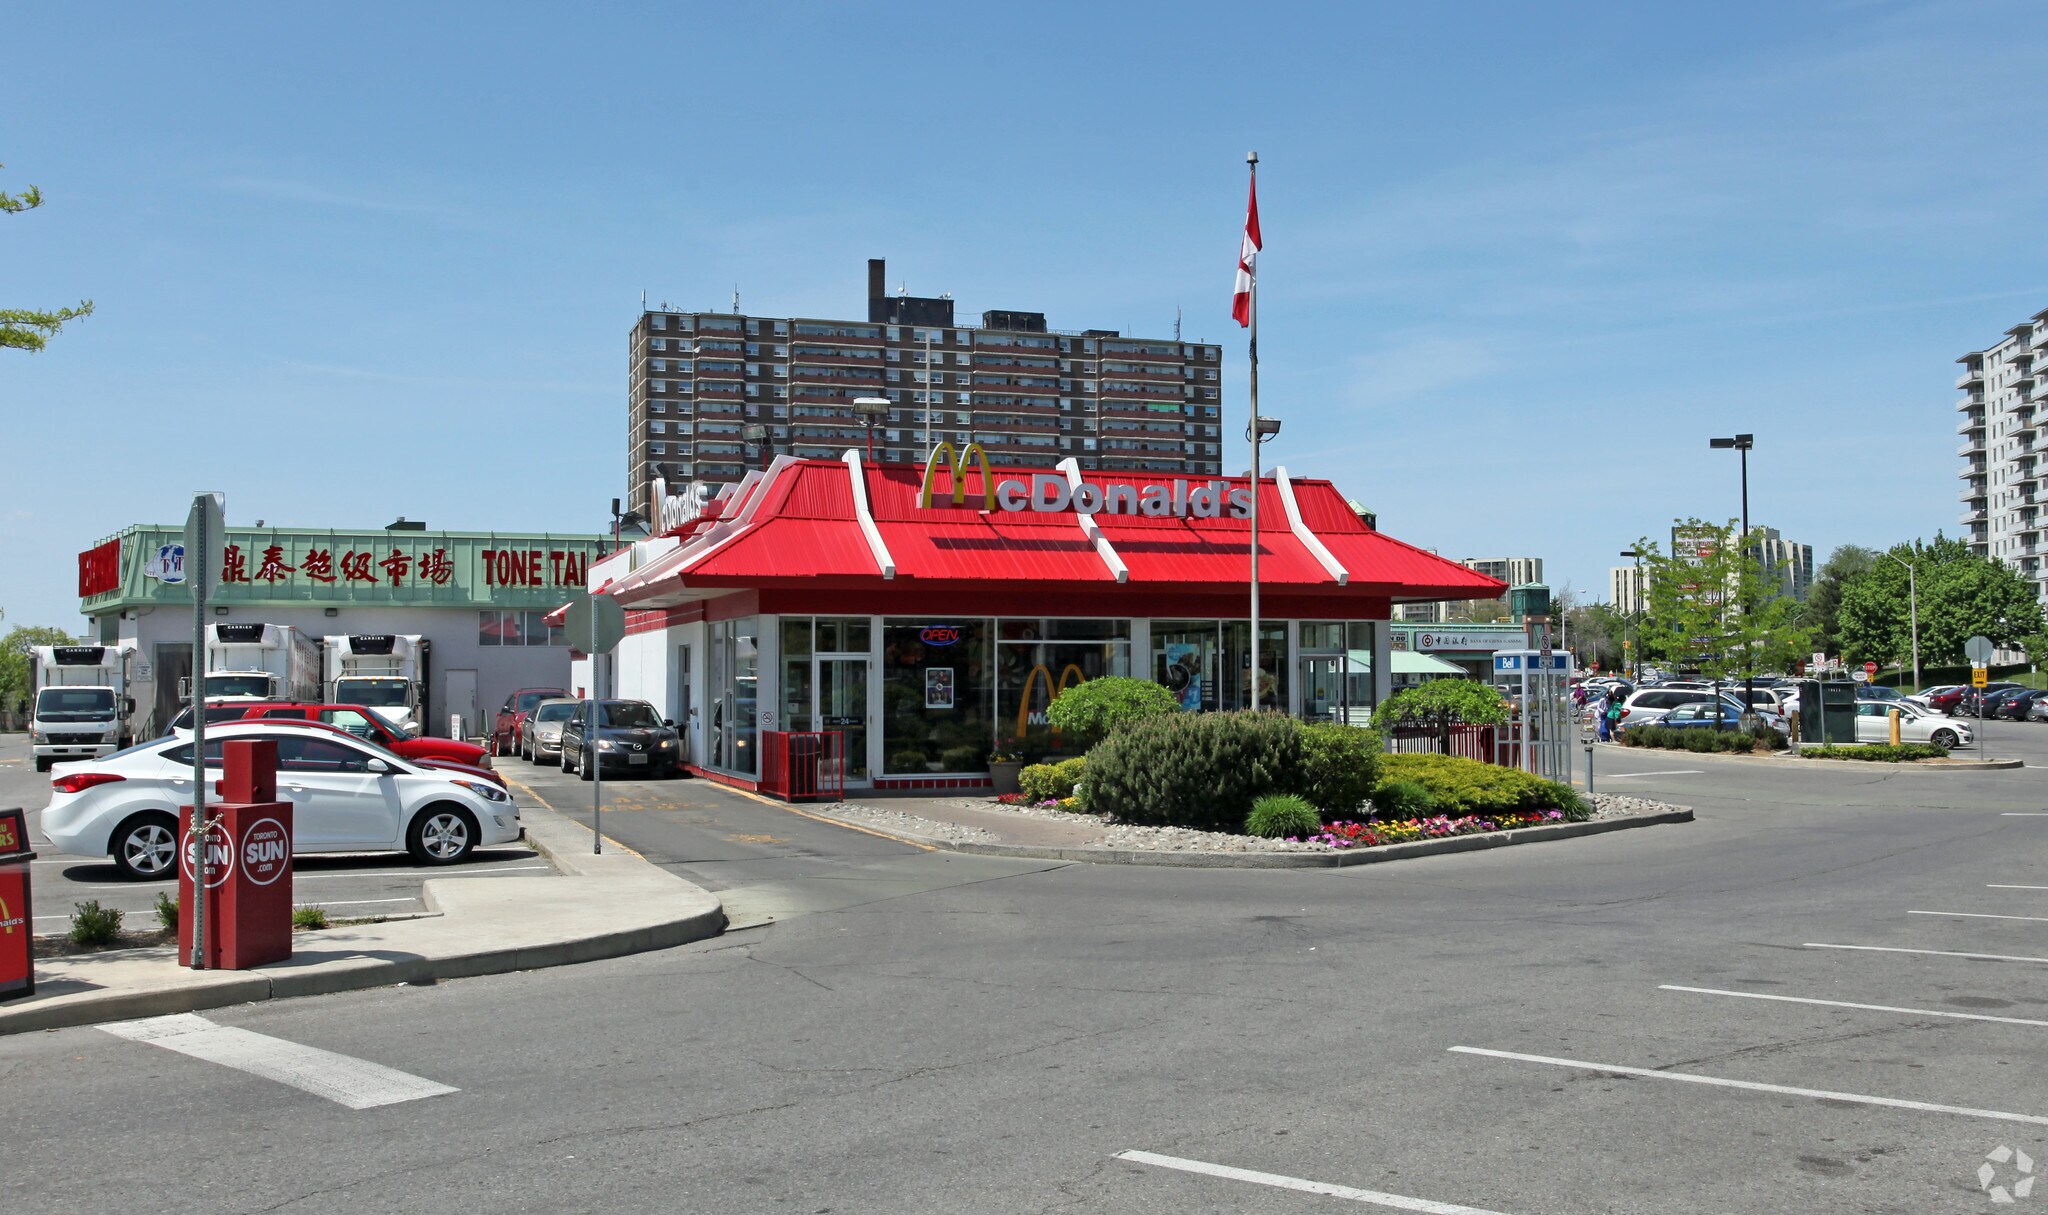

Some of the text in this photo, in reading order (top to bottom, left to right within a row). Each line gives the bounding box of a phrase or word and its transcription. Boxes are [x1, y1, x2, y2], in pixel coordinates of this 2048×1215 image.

[921, 441, 1253, 520] McDonald's
[481, 549, 586, 586] TONE TAI
[921, 629, 959, 641] OPEN
[1502, 657, 1514, 669] Bell
[1974, 671, 1985, 679] EXIT
[253, 831, 278, 841] TORONTO
[246, 840, 285, 864] SUN
[257, 863, 273, 873] .com
